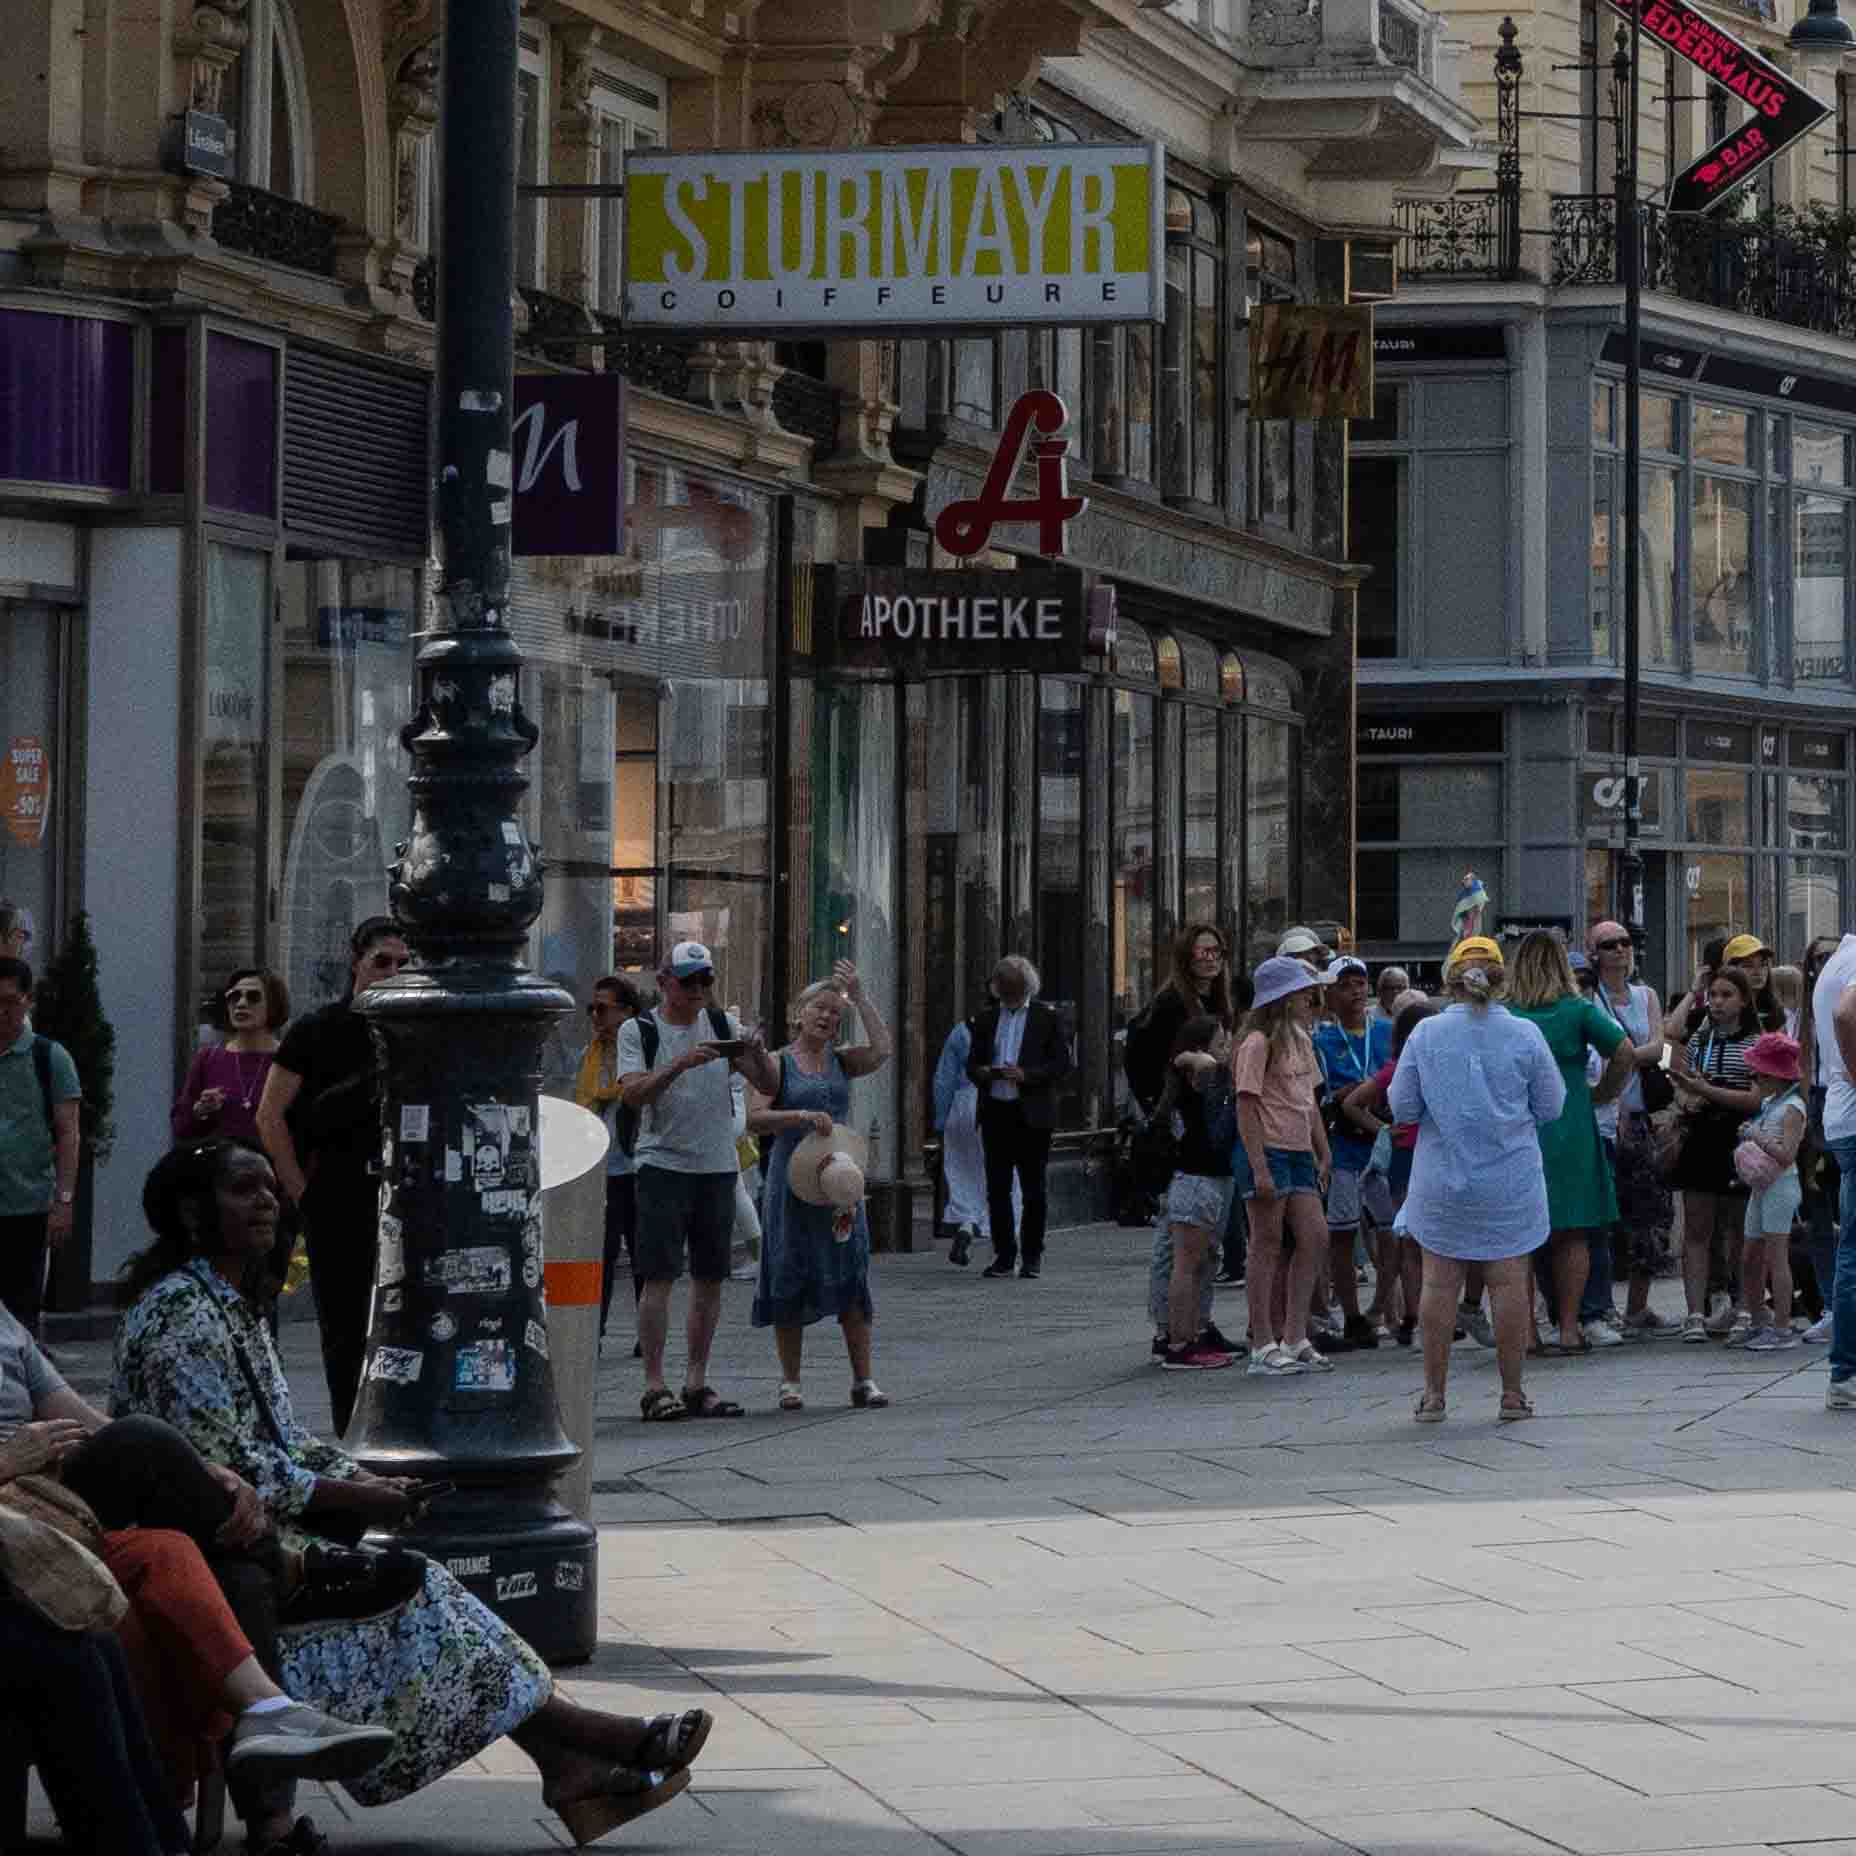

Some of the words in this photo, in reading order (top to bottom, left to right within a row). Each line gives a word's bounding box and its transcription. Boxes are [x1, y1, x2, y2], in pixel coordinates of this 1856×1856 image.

[1720, 127, 1767, 166] BAR
[660, 165, 1119, 286] STURMAYR
[660, 281, 1118, 311] COIFFEURE
[1375, 337, 1416, 352] TAURI
[860, 595, 1064, 640] APOTHEKE
[1366, 728, 1416, 741] TAURI
